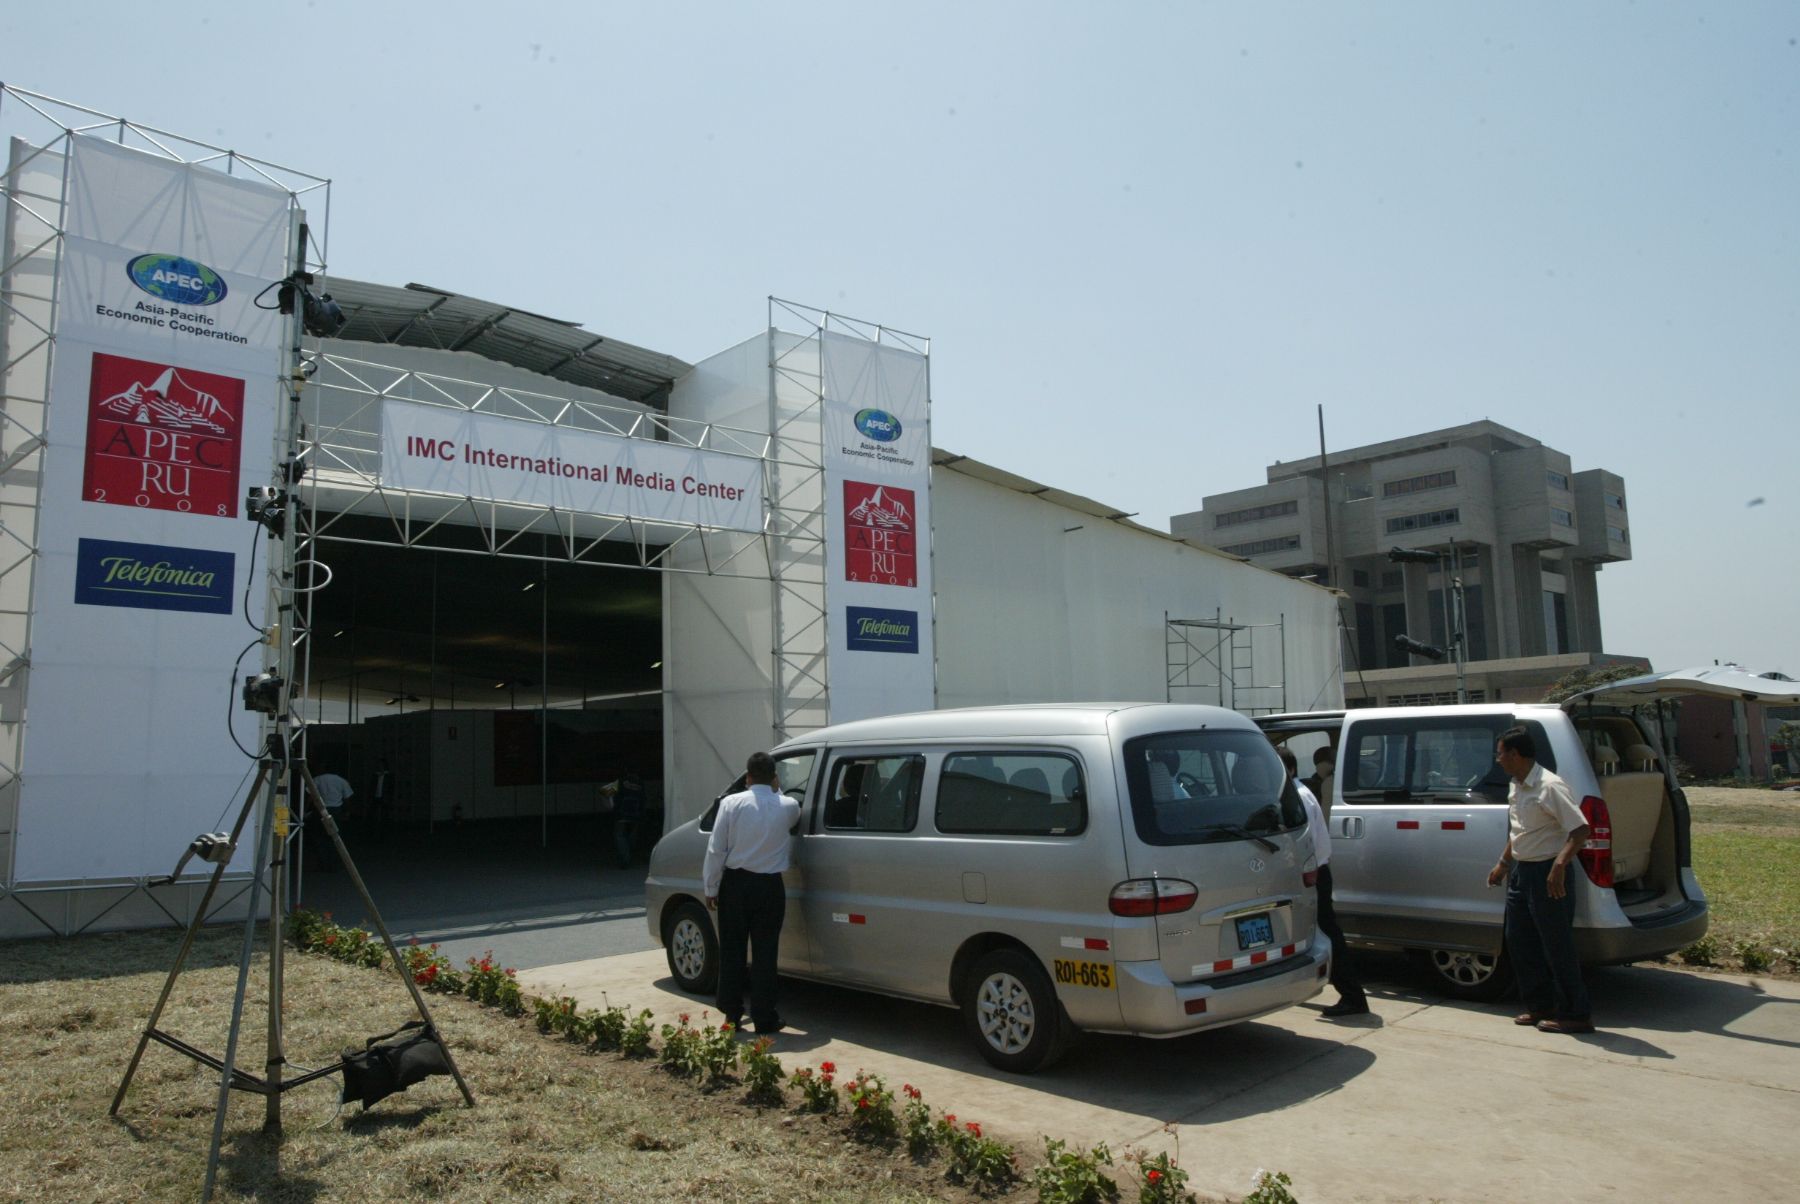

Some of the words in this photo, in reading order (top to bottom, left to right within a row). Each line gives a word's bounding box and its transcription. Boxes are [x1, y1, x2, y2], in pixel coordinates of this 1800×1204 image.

[152, 268, 204, 291] APEC
[96, 304, 165, 327] Economic
[169, 319, 248, 344] Cooperation
[135, 301, 214, 326] Asia-Pacific
[865, 419, 891, 432] APEC
[842, 447, 875, 459] Economic
[876, 453, 914, 466] Cooperation
[860, 442, 898, 455] Asia-Pacific
[140, 461, 190, 496] RU
[407, 435, 456, 462] IMC
[464, 443, 608, 483] International
[616, 466, 676, 493] Media
[681, 476, 745, 501] Center
[871, 552, 896, 575] RU
